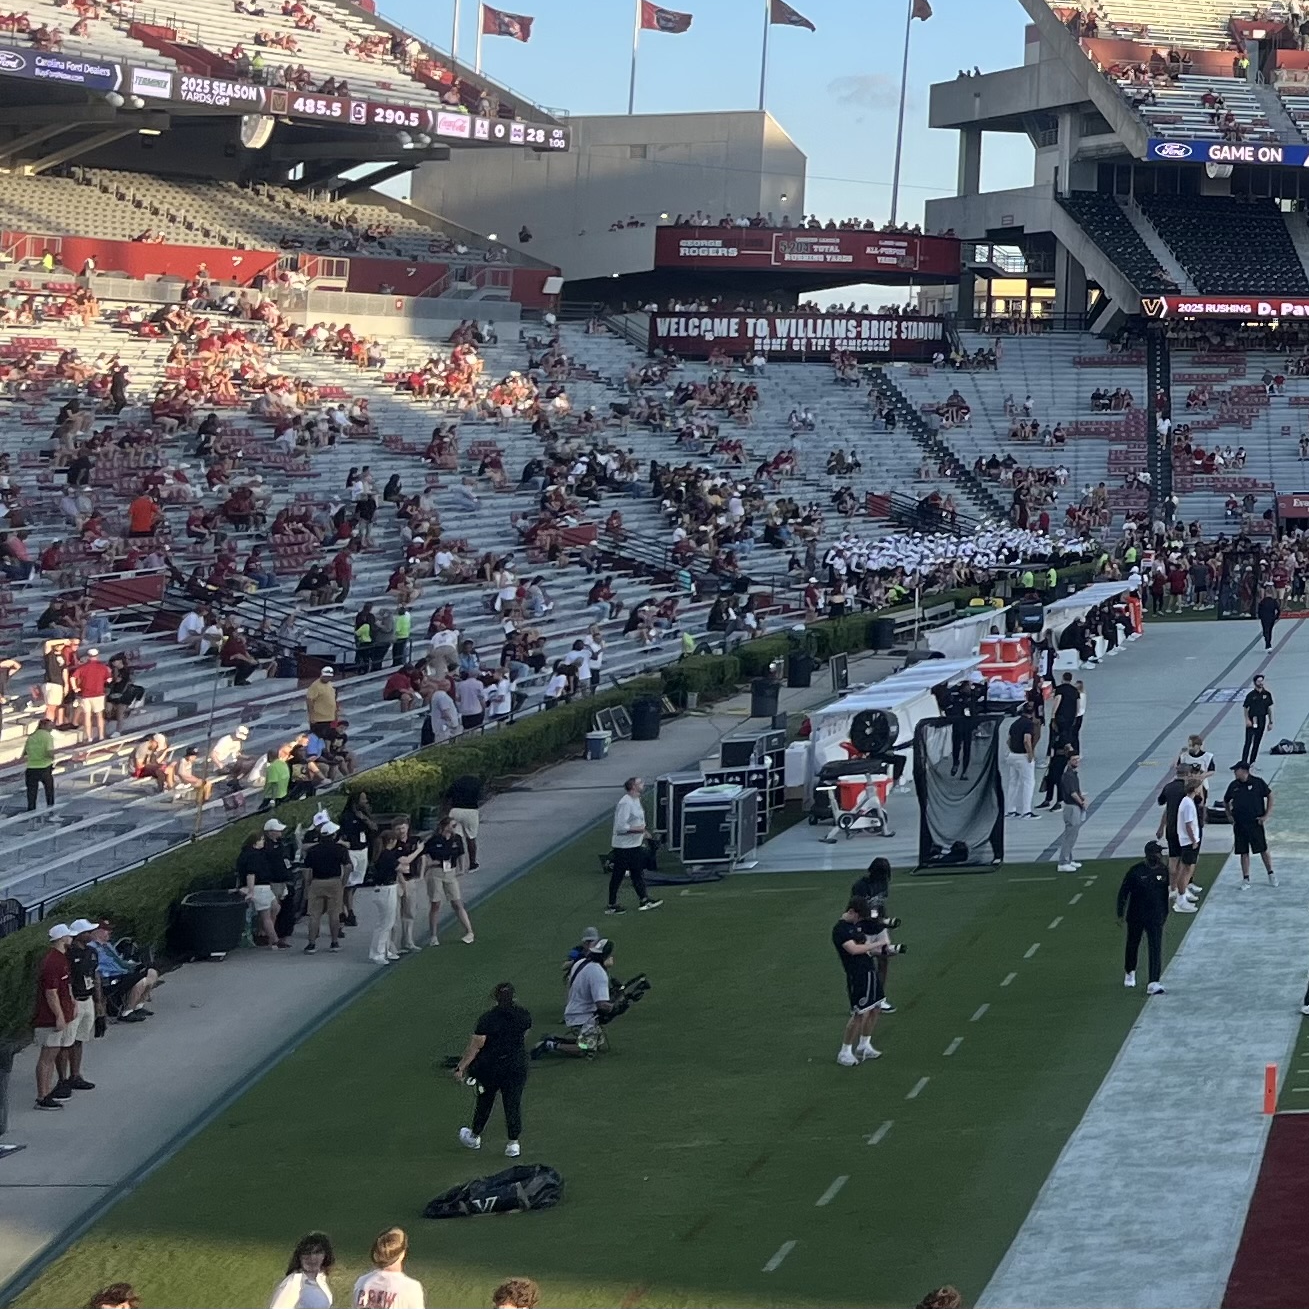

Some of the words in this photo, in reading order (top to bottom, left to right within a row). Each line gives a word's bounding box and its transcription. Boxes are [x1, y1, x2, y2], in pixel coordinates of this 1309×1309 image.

[35, 56, 65, 69] Carolina
[66, 61, 82, 72] Ford
[84, 63, 111, 77] Dealers
[181, 77, 210, 93] 2025
[212, 81, 257, 100] SEASON
[181, 91, 230, 106] YARDS/GM
[293, 98, 342, 116] 485.5
[374, 108, 419, 126] 290.5
[494, 124, 505, 138] 0
[526, 128, 545, 142] 28
[1208, 145, 1254, 161] GAME
[1258, 147, 1282, 162] ON
[679, 247, 738, 256] ROGERS
[813, 245, 840, 253] TOTAL
[1177, 303, 1203, 313] 2025
[1205, 303, 1251, 314] RUSHING
[1257, 303, 1277, 316] D.
[656, 317, 740, 338] WELCOME
[745, 318, 769, 338] TO
[901, 321, 943, 340] STADIUM
[753, 338, 788, 351] HOME
[792, 338, 808, 351] OF
[811, 338, 831, 351] THE
[834, 339, 891, 352] GAMECOCKS
